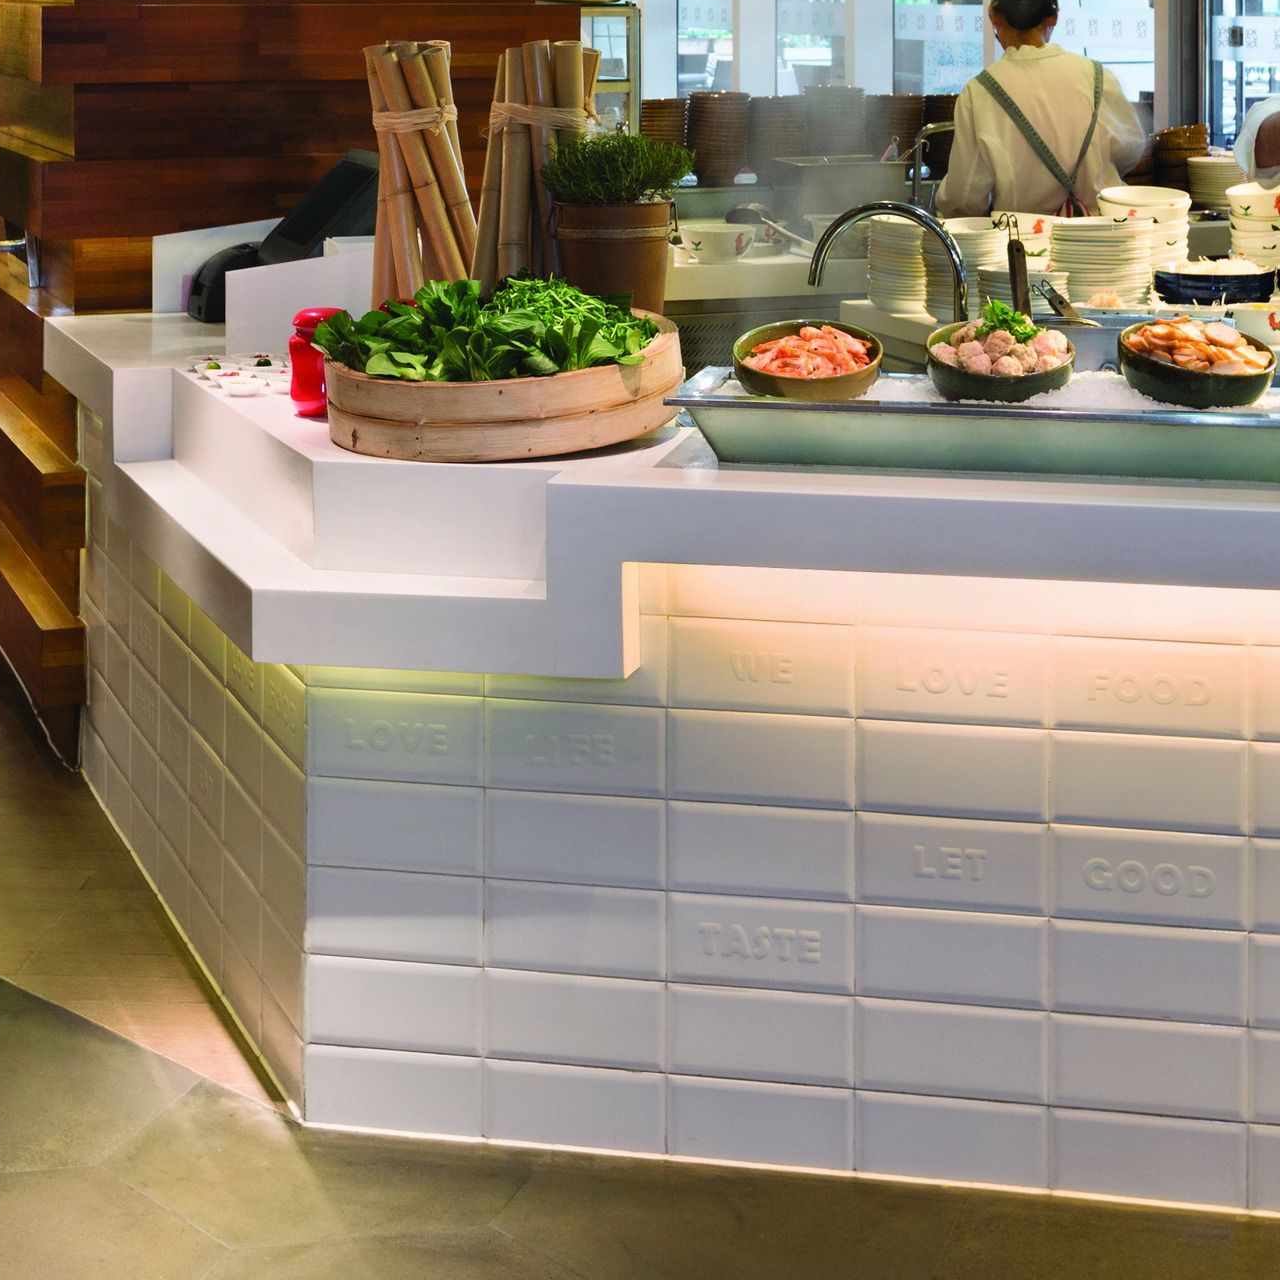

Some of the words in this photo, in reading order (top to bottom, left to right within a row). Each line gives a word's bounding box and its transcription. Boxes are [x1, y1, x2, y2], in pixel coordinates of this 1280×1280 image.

[729, 648, 794, 684] WE
[895, 658, 1009, 699] LOVE
[1086, 669, 1213, 708] FOOD
[345, 717, 449, 756] LOVE
[526, 732, 616, 767] LIFE
[914, 844, 989, 882] LET
[1082, 856, 1217, 899] GOOD
[698, 922, 823, 965] TASTE
